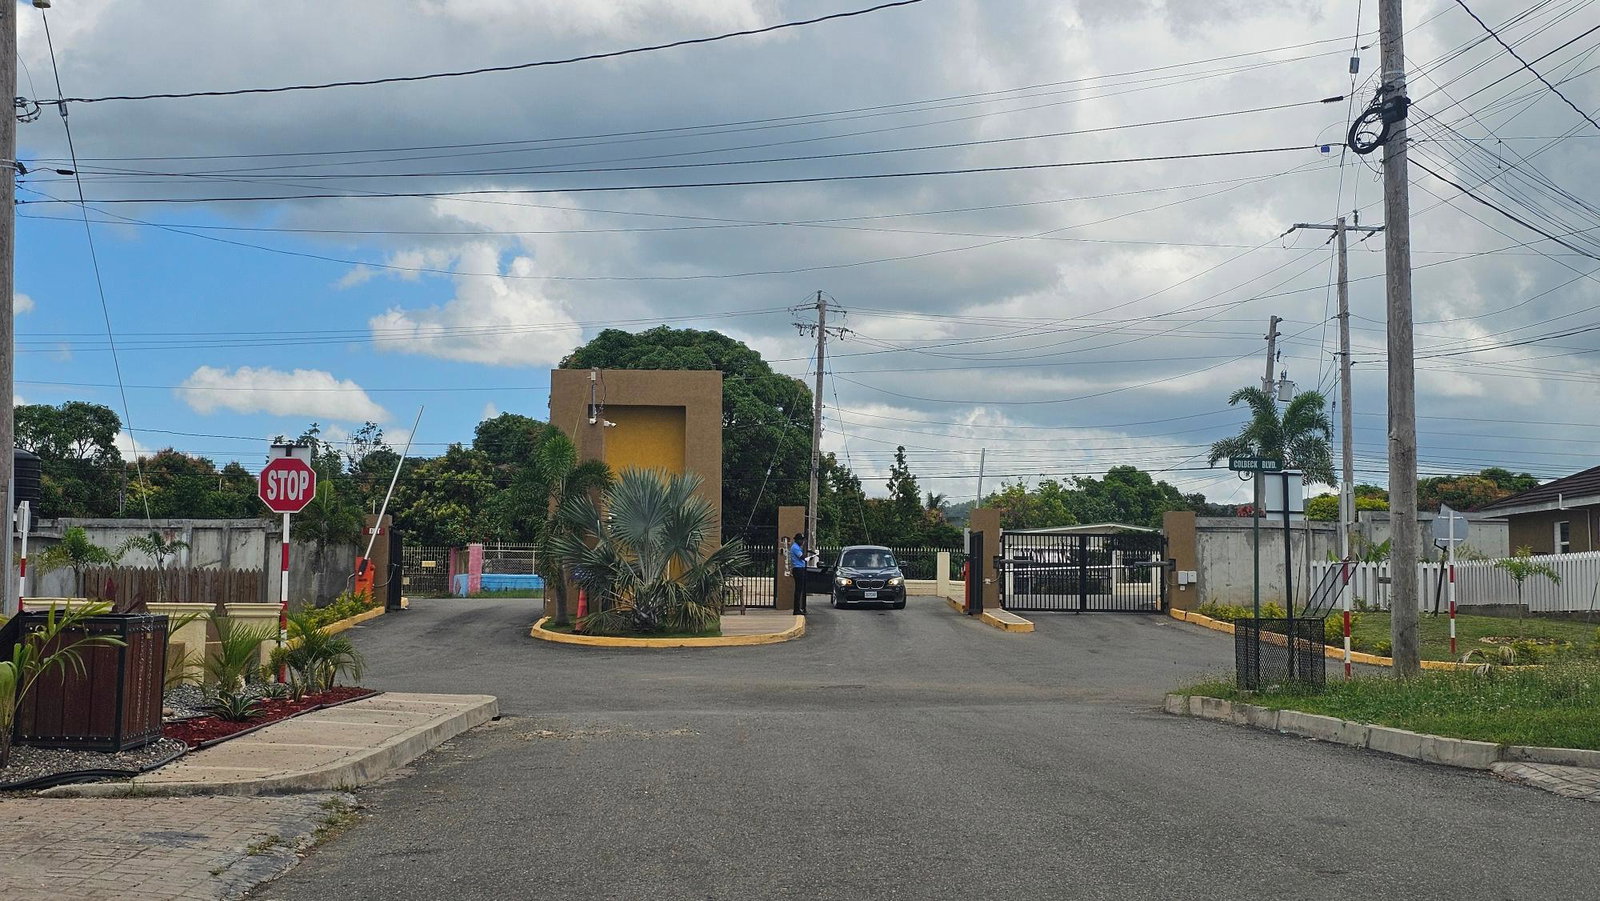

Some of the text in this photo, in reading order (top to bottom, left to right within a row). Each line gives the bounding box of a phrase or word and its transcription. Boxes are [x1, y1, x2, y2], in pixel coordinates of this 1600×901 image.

[1233, 460, 1277, 469] COLBECK BLVD.
[267, 470, 309, 500] STOP
